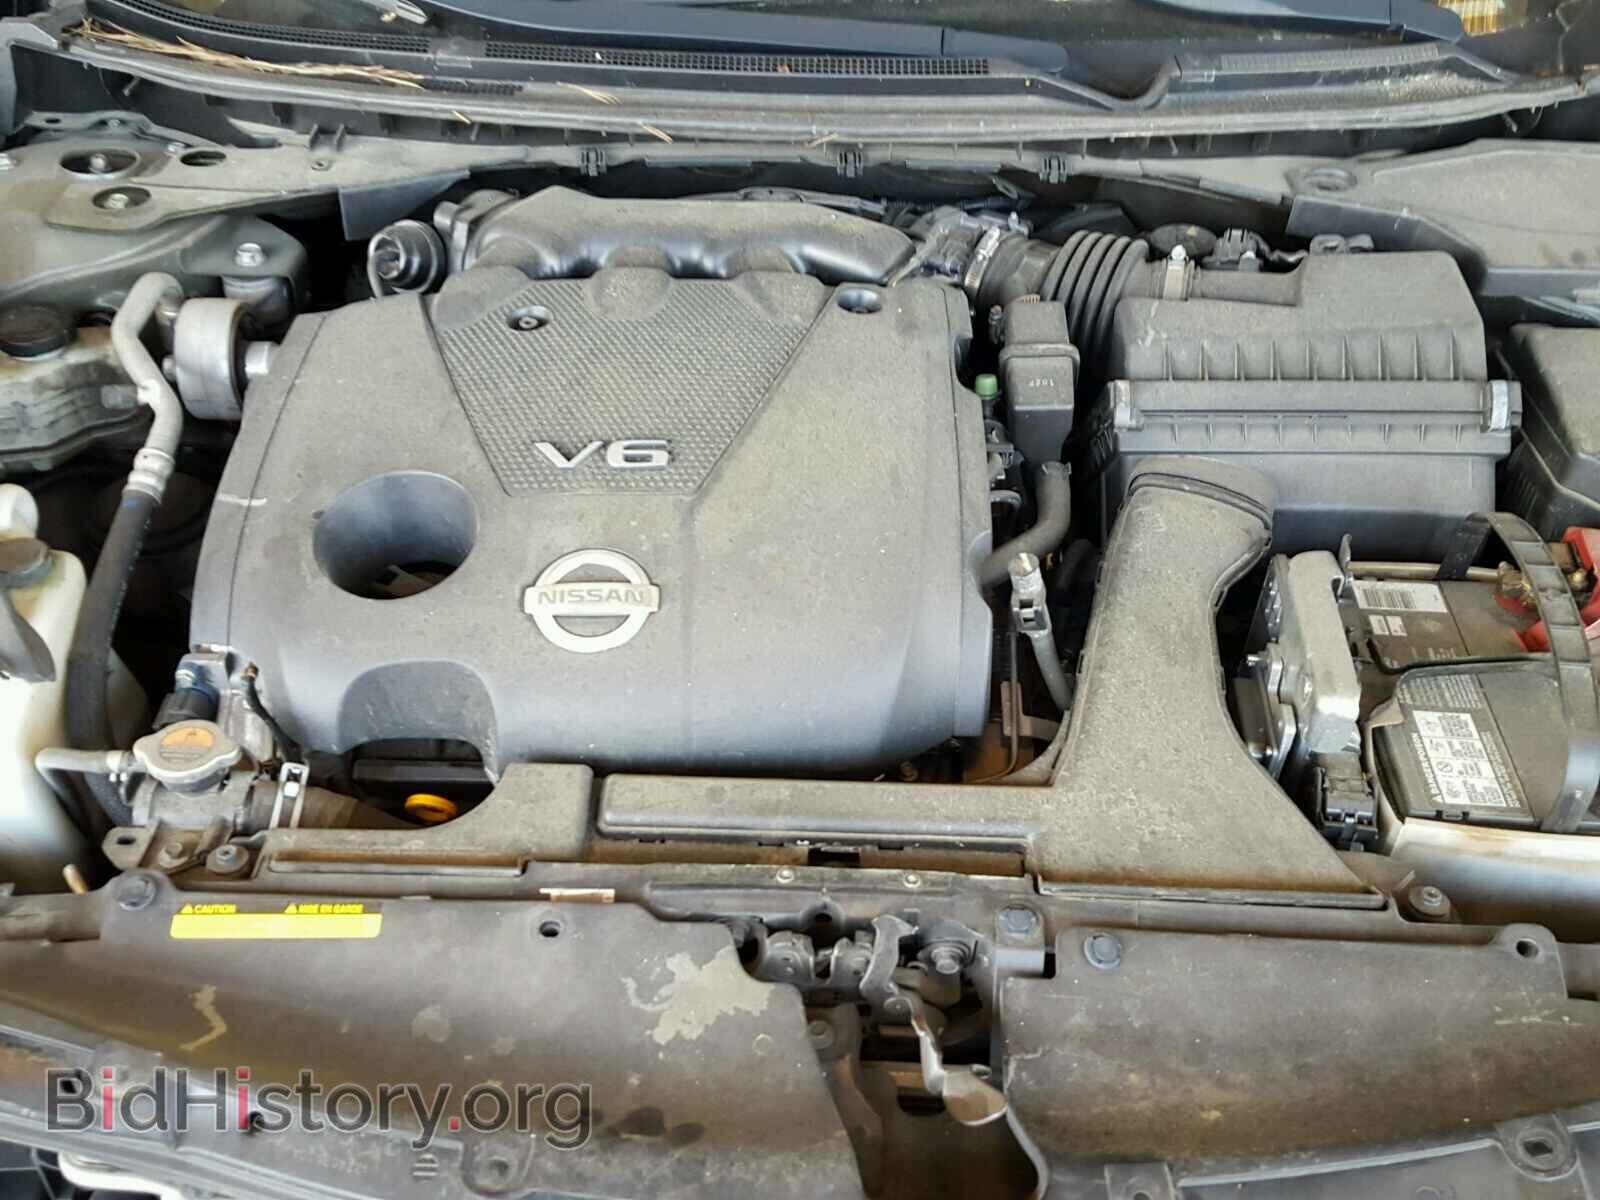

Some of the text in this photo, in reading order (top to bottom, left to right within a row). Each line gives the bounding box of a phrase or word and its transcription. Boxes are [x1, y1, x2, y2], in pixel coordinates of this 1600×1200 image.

[534, 439, 671, 470] V6
[537, 587, 645, 606] NISSAN
[194, 903, 237, 914] CAUTION
